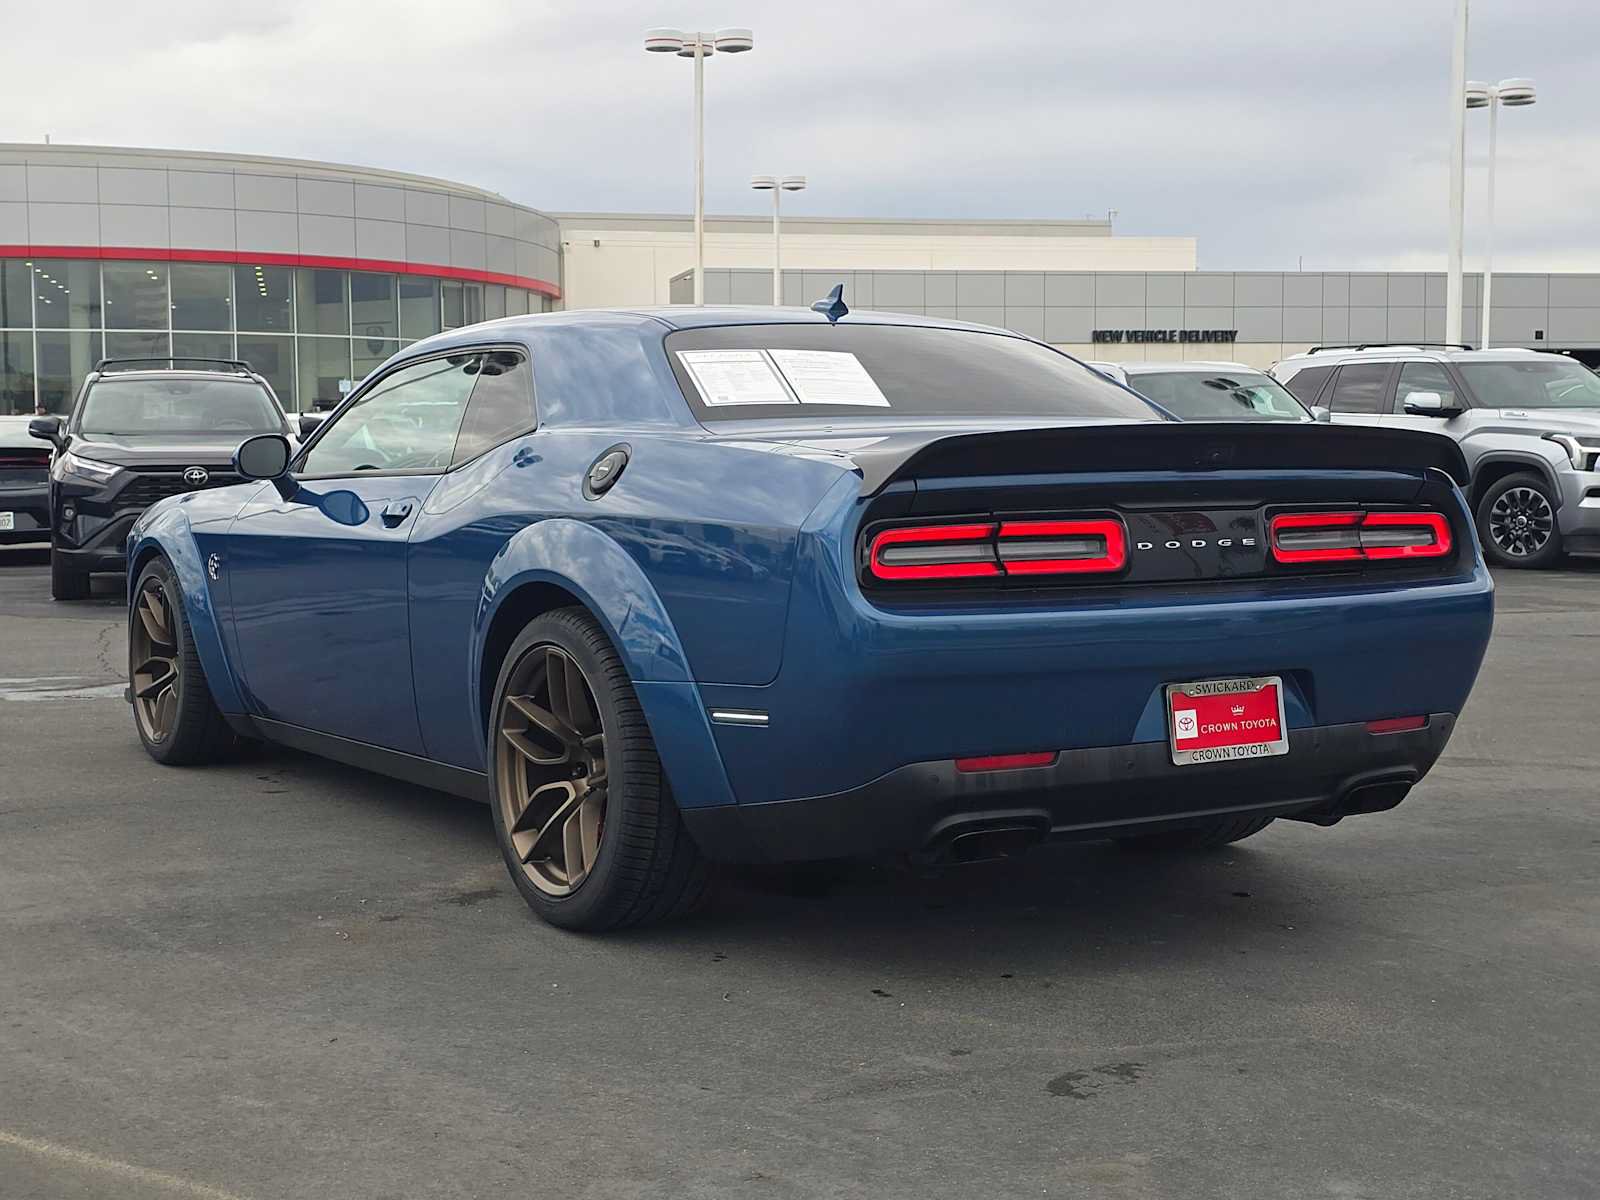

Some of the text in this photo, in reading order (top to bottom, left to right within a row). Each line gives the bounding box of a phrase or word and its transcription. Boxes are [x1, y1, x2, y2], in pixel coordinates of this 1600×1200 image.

[1092, 330, 1238, 343] NEW VEHICLE DELIVERY
[1137, 538, 1256, 550] DODGE
[1195, 680, 1254, 695] SWICKARD
[1200, 718, 1277, 734] CROWN TOYOTA
[1191, 744, 1270, 762] CROWN TOYOTA
